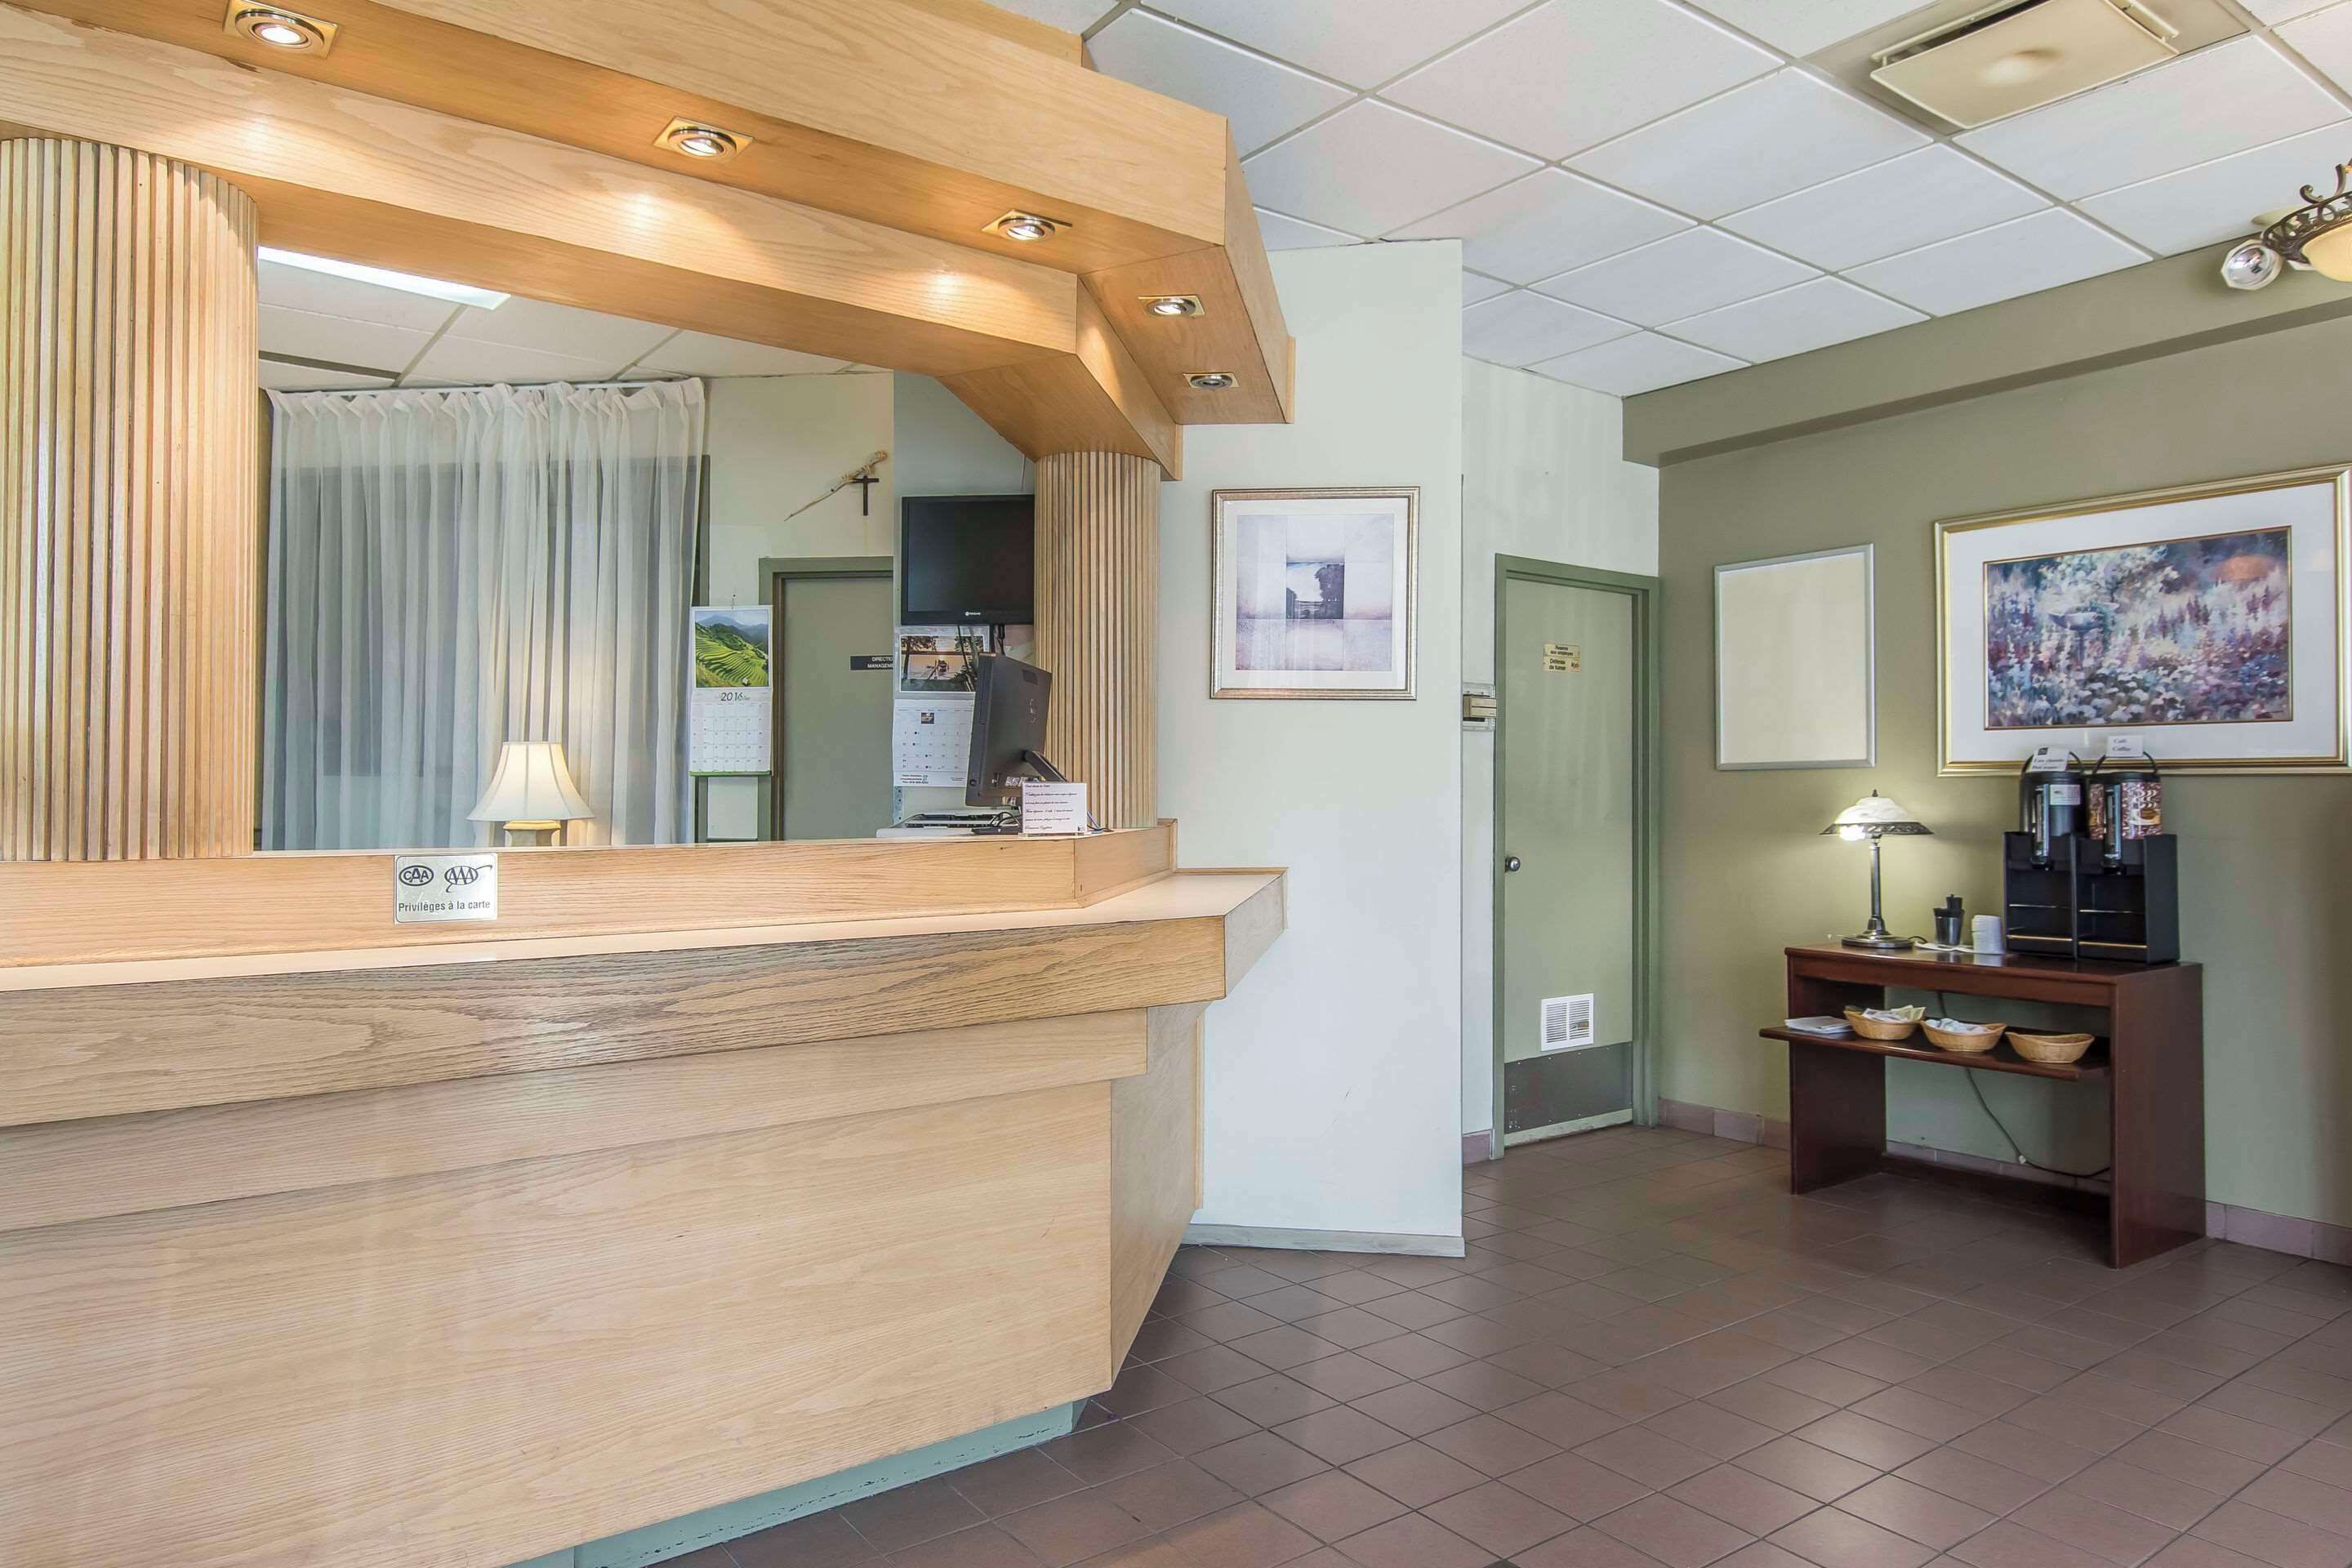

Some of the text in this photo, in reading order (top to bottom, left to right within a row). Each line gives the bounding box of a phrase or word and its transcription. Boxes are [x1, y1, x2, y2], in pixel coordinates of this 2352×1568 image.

[720, 692, 744, 702] 2016
[401, 865, 475, 885] CAA AAA
[399, 901, 491, 912] Privilèges à la carte
